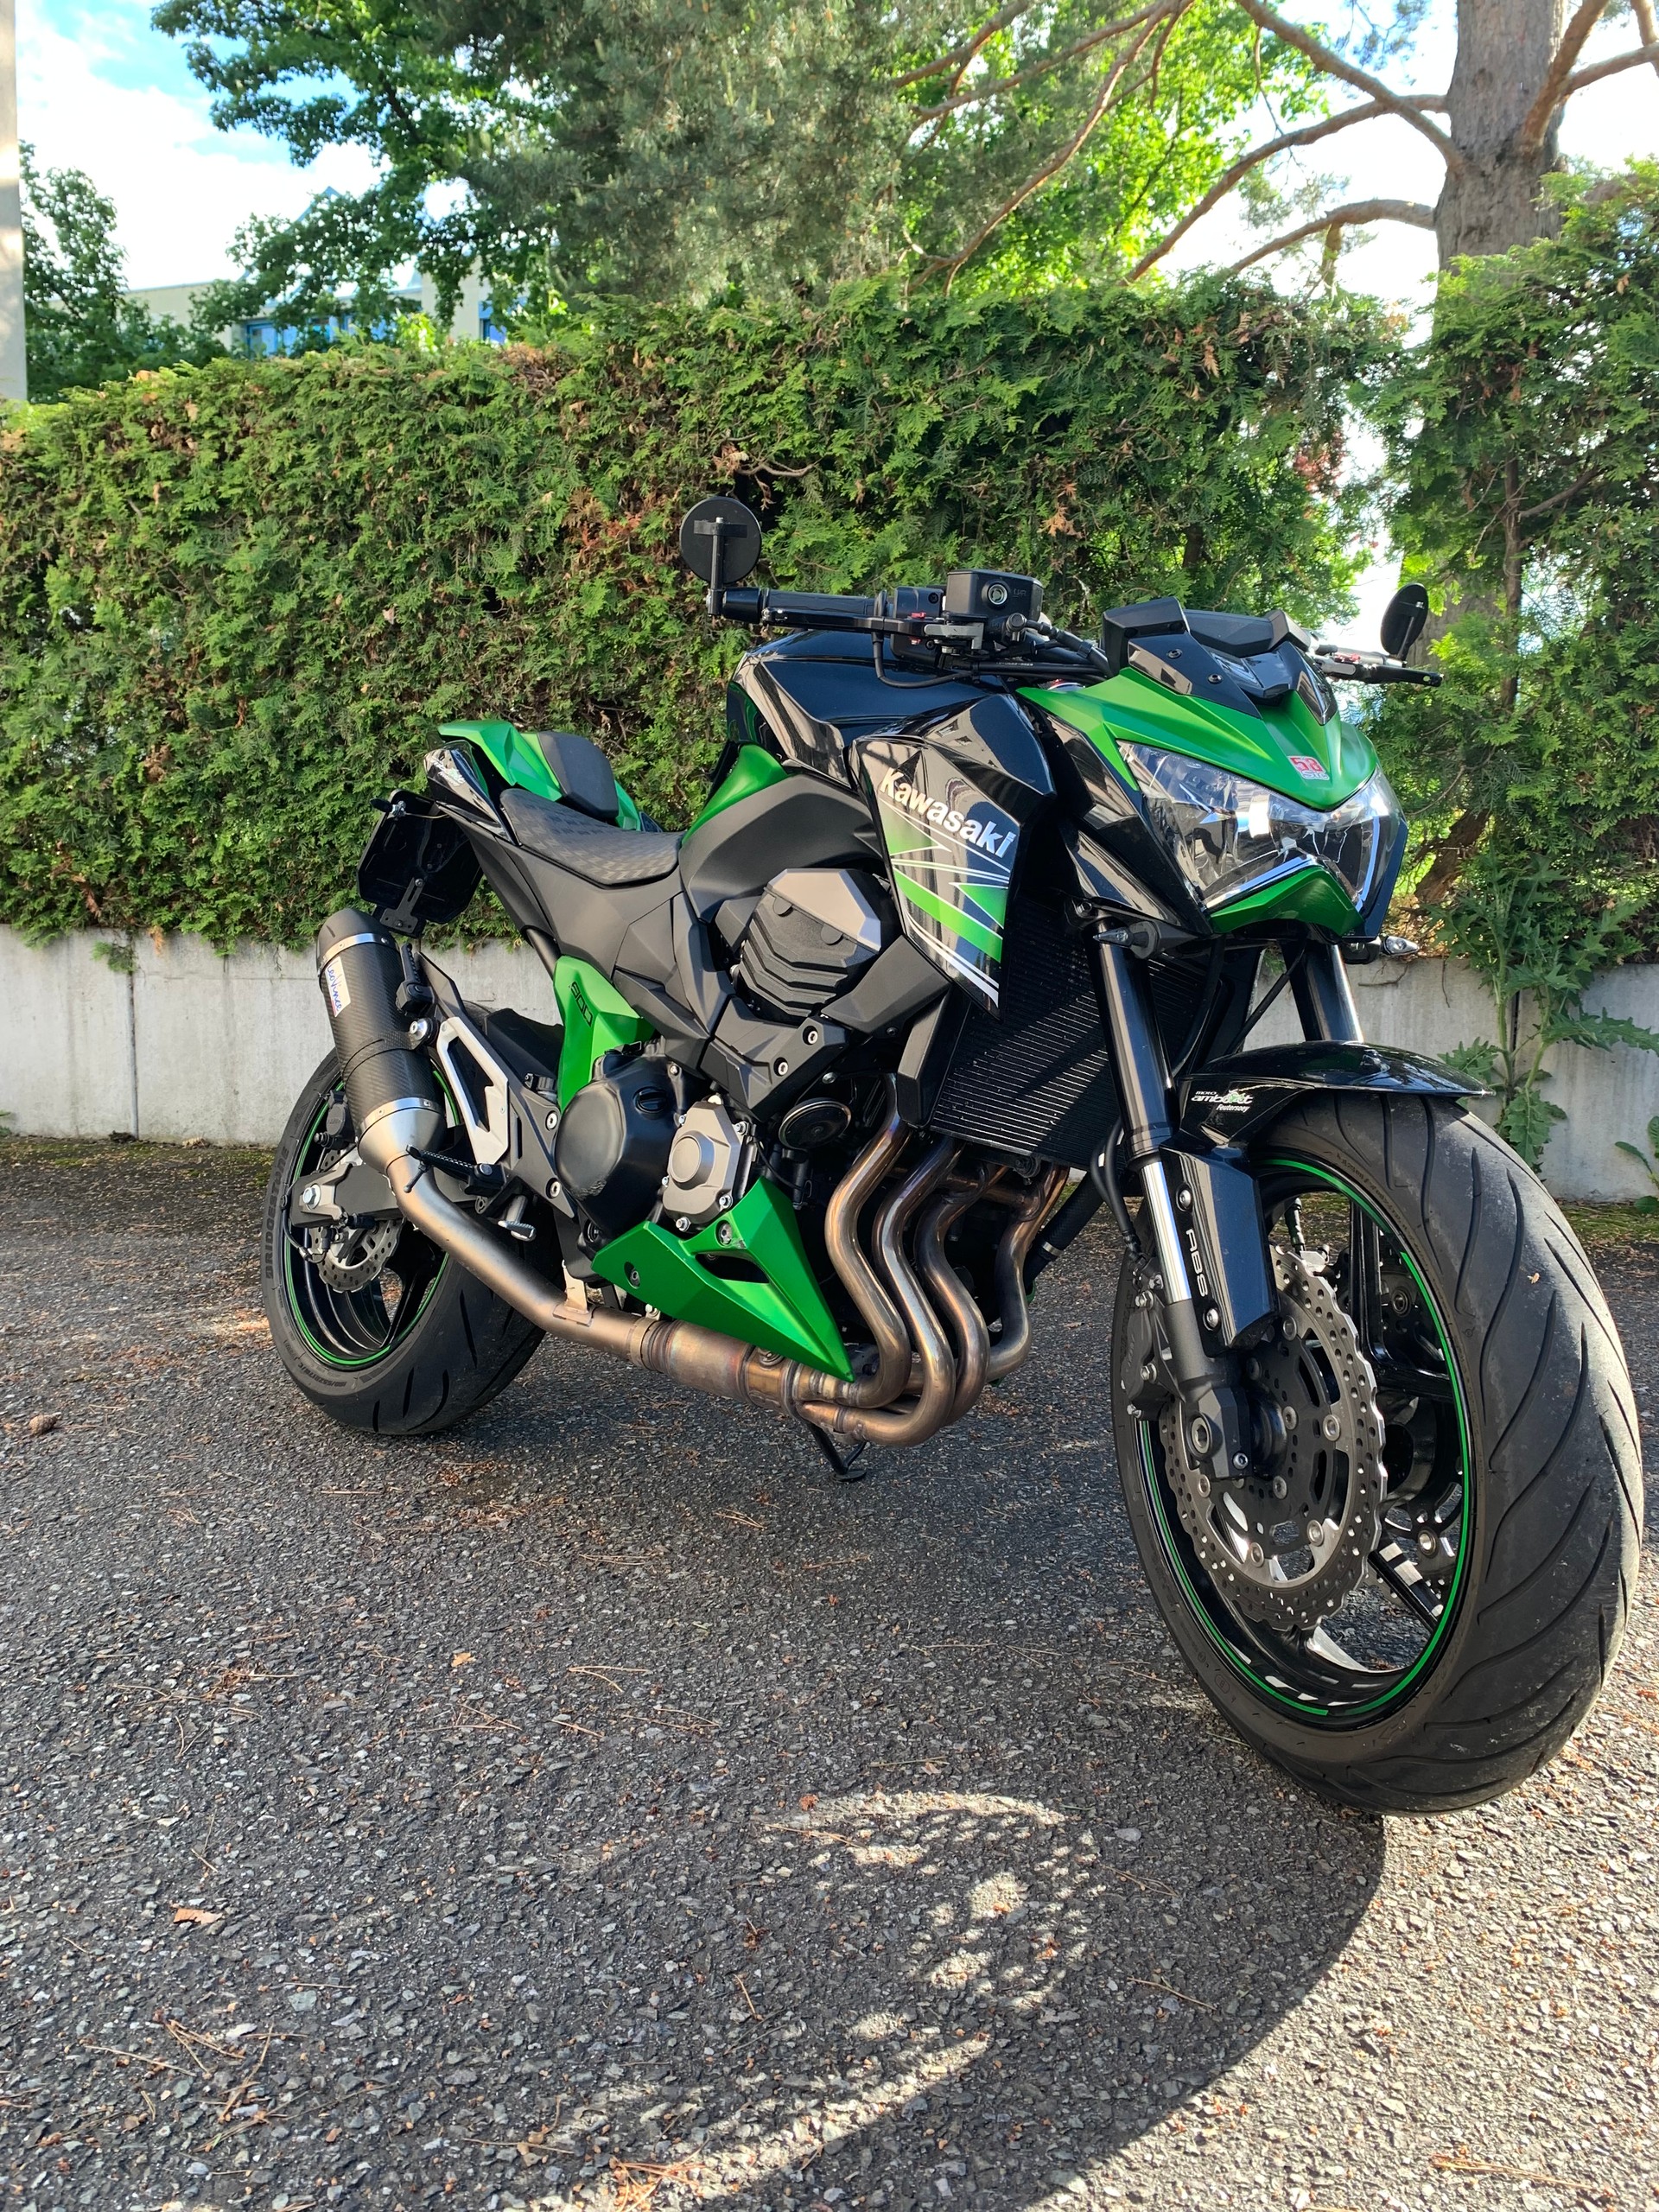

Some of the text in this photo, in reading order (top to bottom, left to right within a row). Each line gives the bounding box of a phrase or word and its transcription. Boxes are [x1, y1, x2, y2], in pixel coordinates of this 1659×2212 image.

[1290, 757, 1323, 772] 58
[880, 768, 1016, 858] Kawasaki
[264, 1147, 289, 1279] BRIDGESTONE
[1185, 1229, 1208, 1297] ABS
